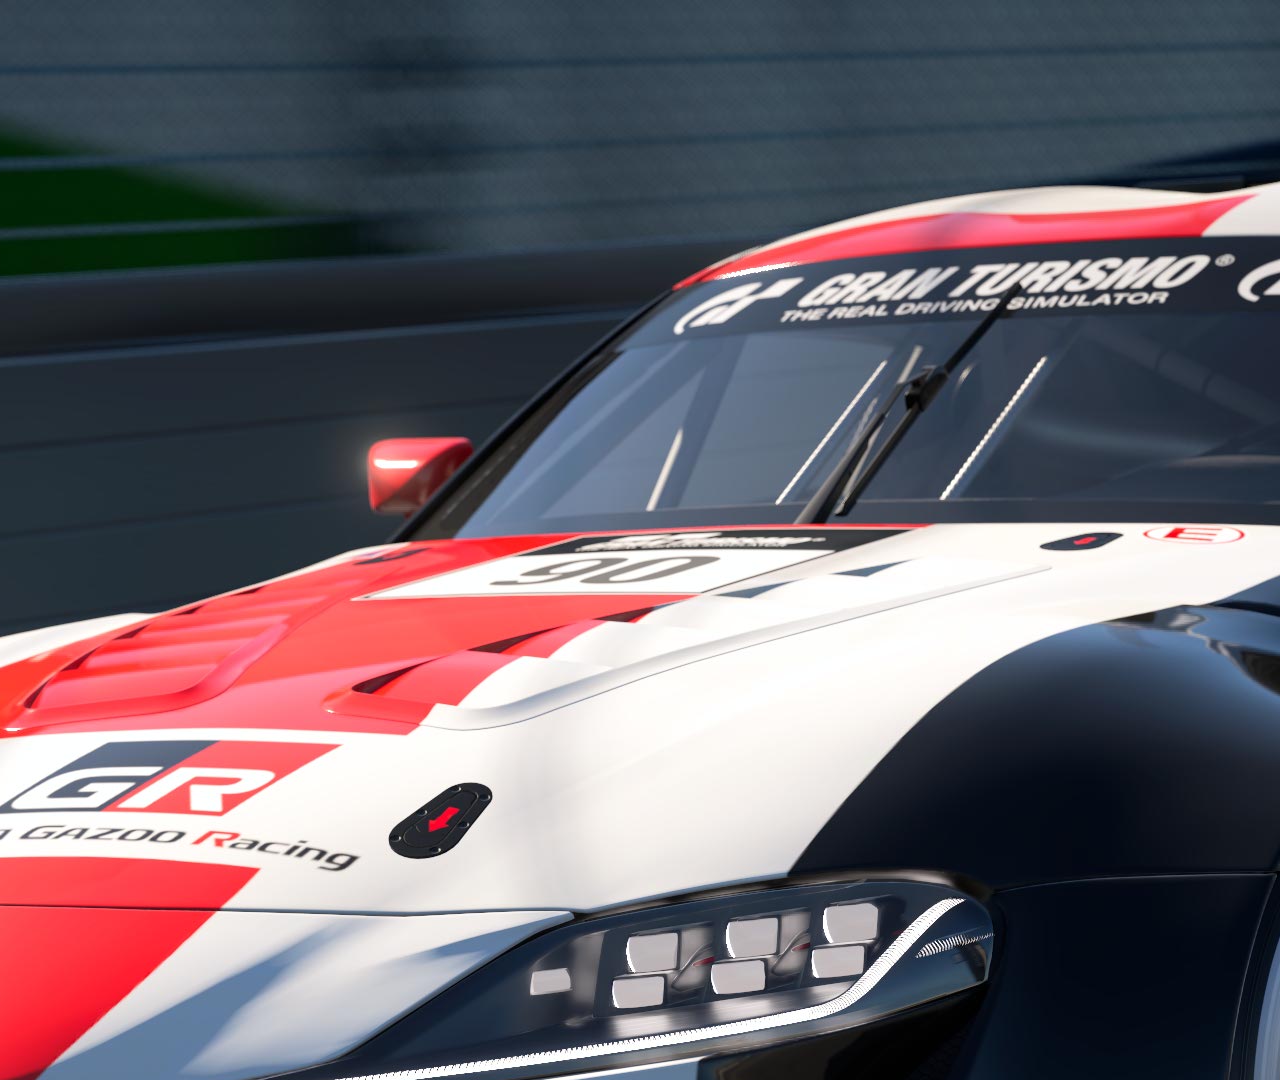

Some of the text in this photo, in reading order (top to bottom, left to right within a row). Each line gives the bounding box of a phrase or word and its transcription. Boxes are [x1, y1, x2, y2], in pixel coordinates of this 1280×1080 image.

[780, 291, 1170, 323] THE REAL DRIVING SIMULATOR
[797, 265, 960, 308] GRAN
[489, 556, 721, 585] 90
[11, 766, 277, 813] GR
[19, 825, 187, 844] GAZOO
[191, 830, 361, 872] Racing
